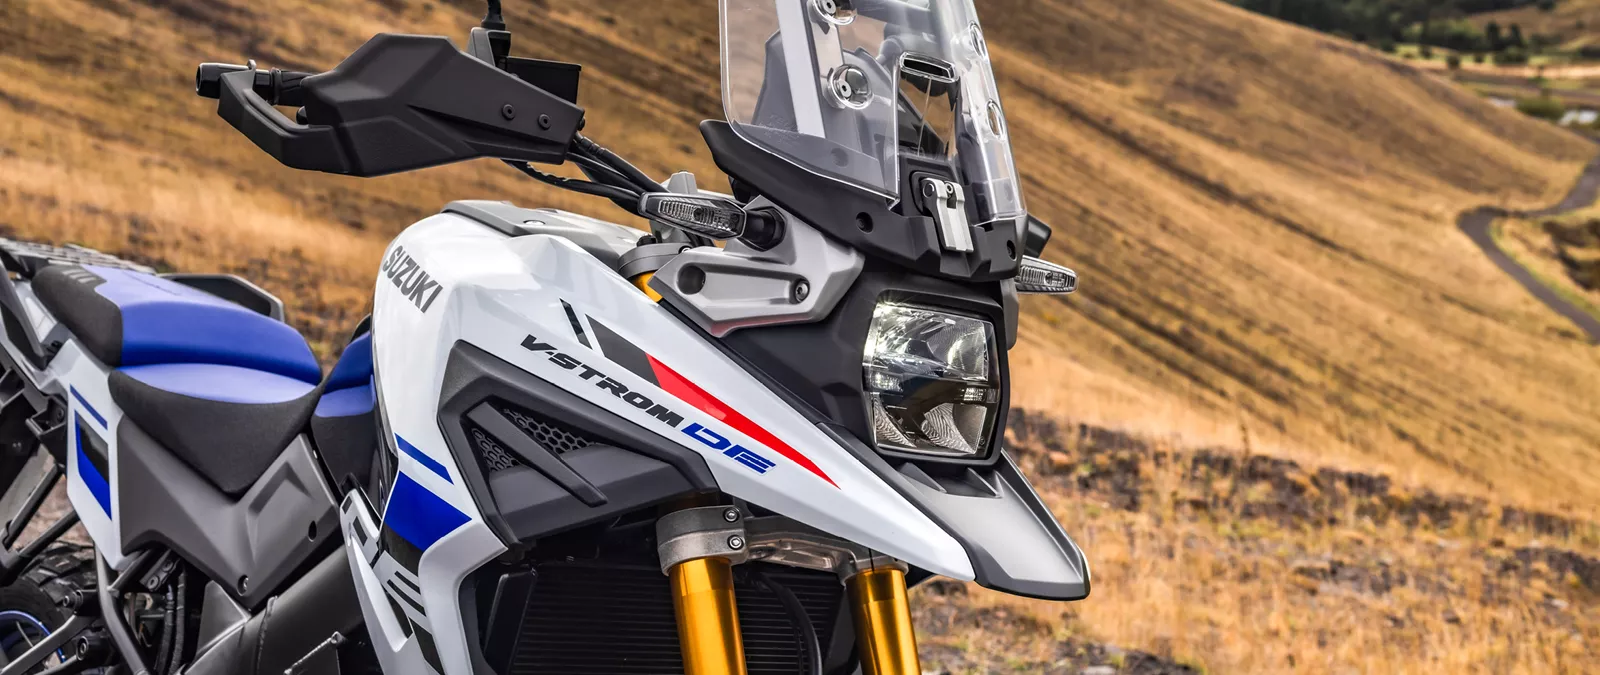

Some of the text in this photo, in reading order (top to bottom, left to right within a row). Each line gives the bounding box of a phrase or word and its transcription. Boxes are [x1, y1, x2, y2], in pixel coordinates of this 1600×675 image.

[383, 246, 443, 313] SUZUKI
[520, 334, 776, 474] V-STROM DE
